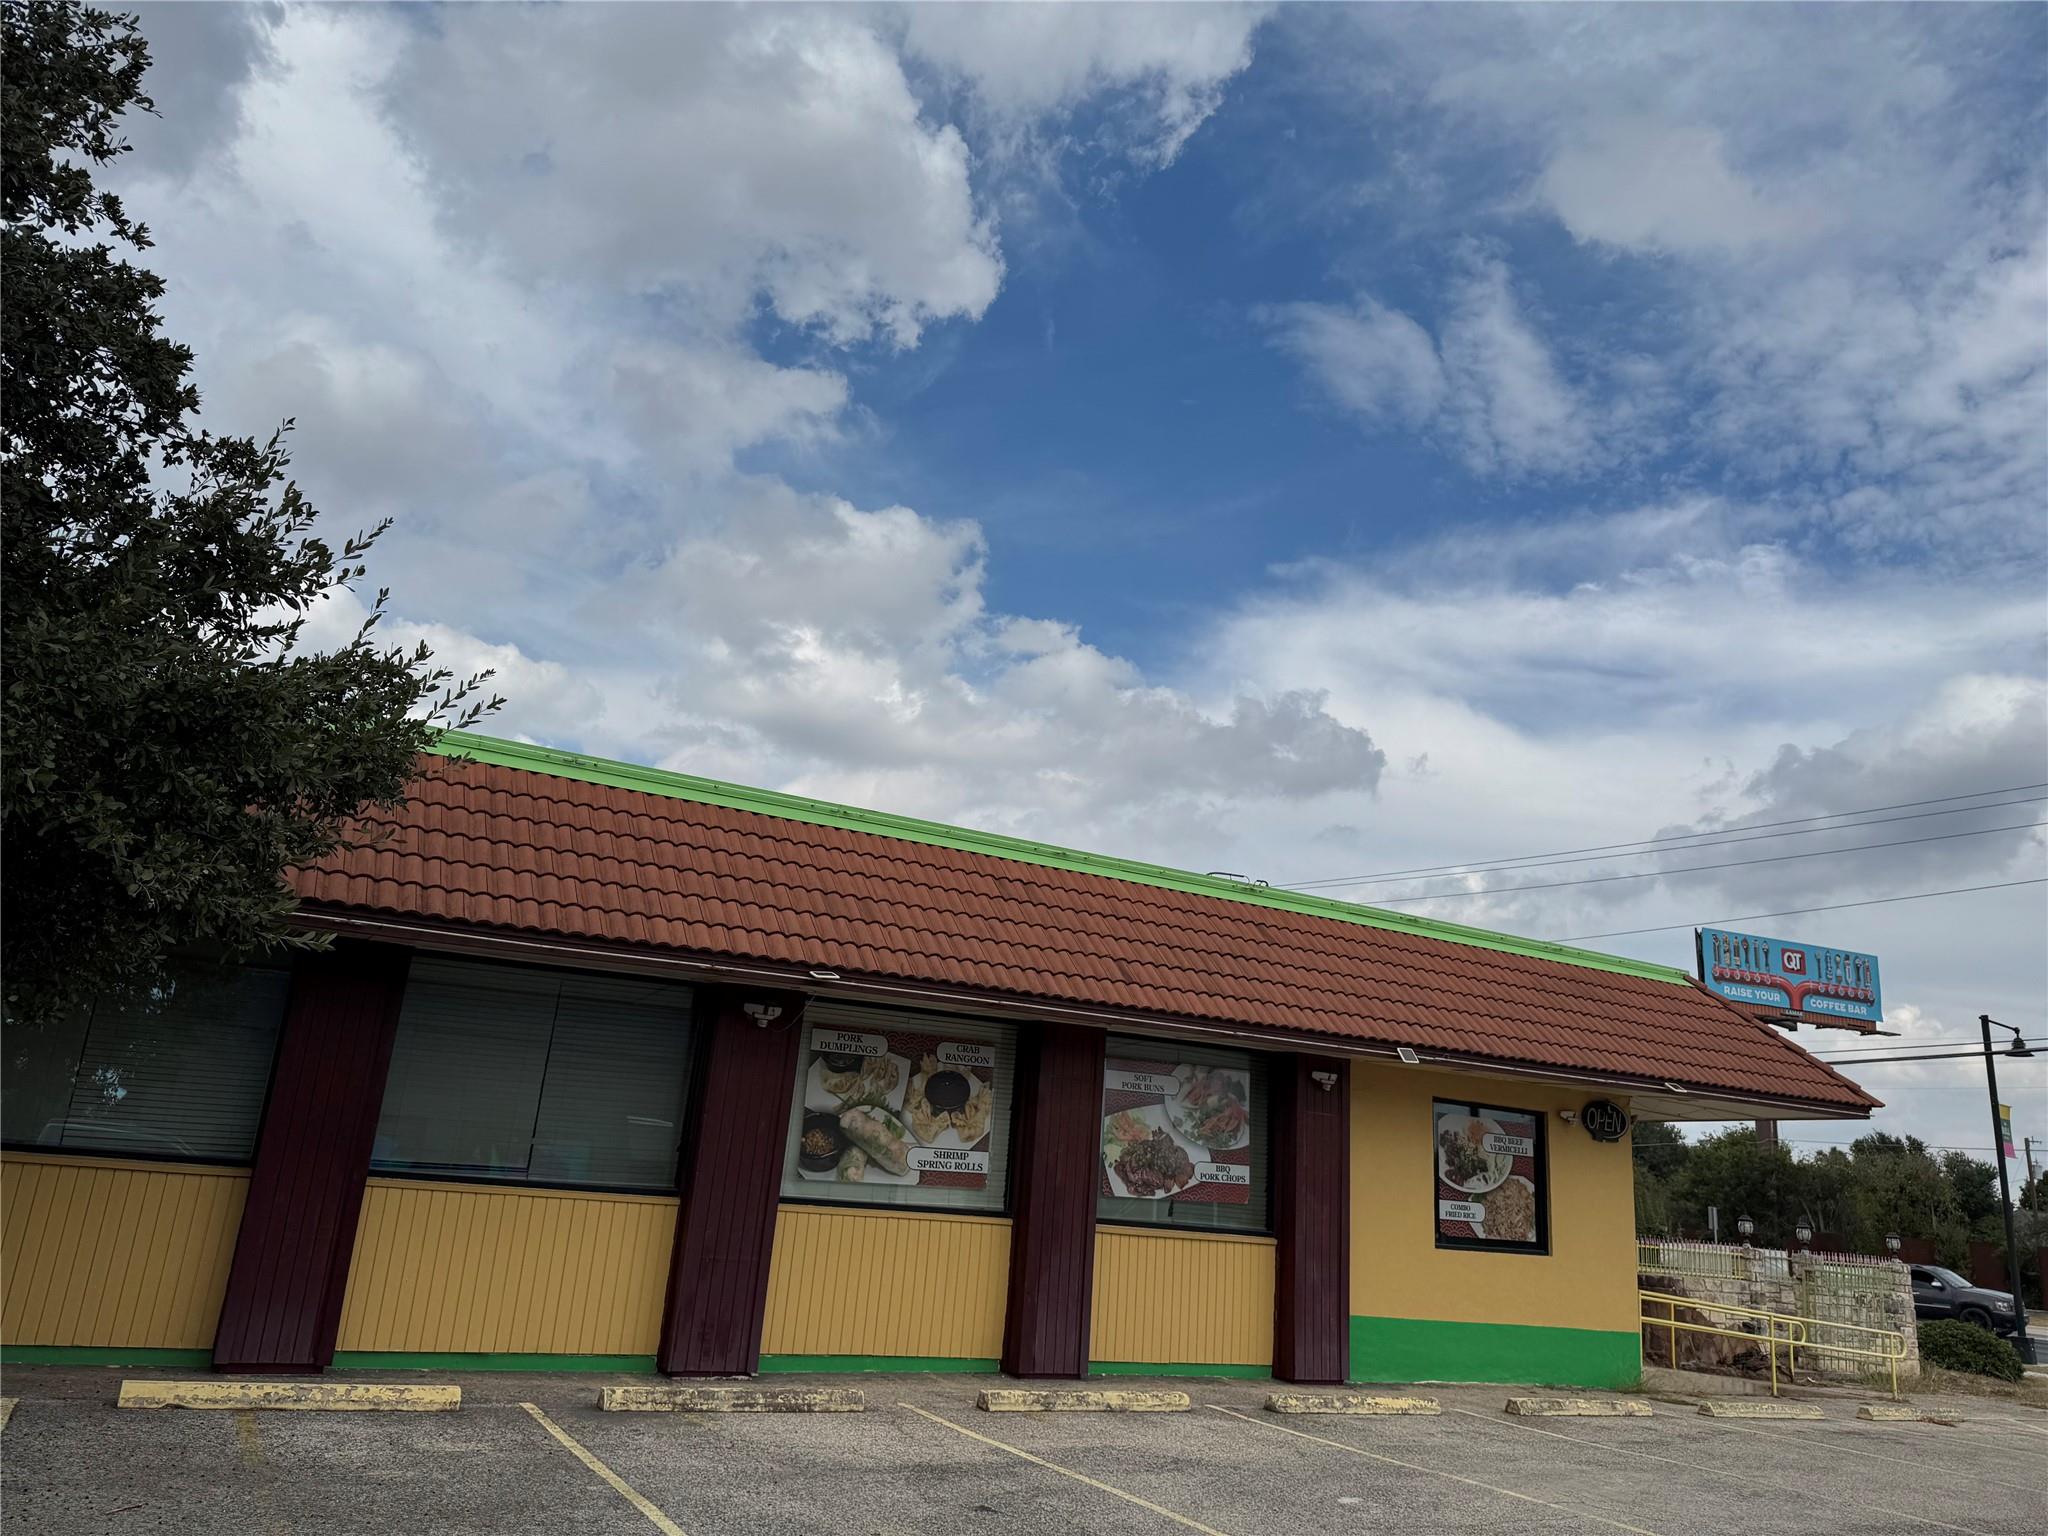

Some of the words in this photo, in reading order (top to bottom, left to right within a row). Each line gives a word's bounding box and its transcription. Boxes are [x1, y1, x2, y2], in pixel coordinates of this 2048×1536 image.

[1784, 952, 1802, 970] QT
[1724, 985, 1753, 998] RAISE
[1754, 990, 1781, 1002] YOUR
[1810, 998, 1846, 1012] COFFEE
[1847, 1004, 1867, 1015] BAR
[837, 1033, 864, 1044] PORK
[819, 1042, 878, 1055] DUMPLINGS
[956, 1044, 980, 1054] CRAB
[945, 1054, 990, 1065] RANGOON
[1134, 1074, 1152, 1082] SOFT
[1121, 1081, 1143, 1091] PORK
[1144, 1083, 1165, 1093] BUNS
[1586, 1107, 1621, 1132] OPEN
[1493, 1136, 1507, 1144] BBQ
[1508, 1137, 1523, 1146] BEEF
[1490, 1143, 1528, 1154] VERMICELLI
[933, 1150, 969, 1161] SHRIMP
[917, 1160, 952, 1170] SPRING
[954, 1162, 983, 1172] ROLLS
[1215, 1165, 1231, 1174] BBQ
[1200, 1173, 1220, 1182] PORK
[1221, 1174, 1246, 1183] CHOPS
